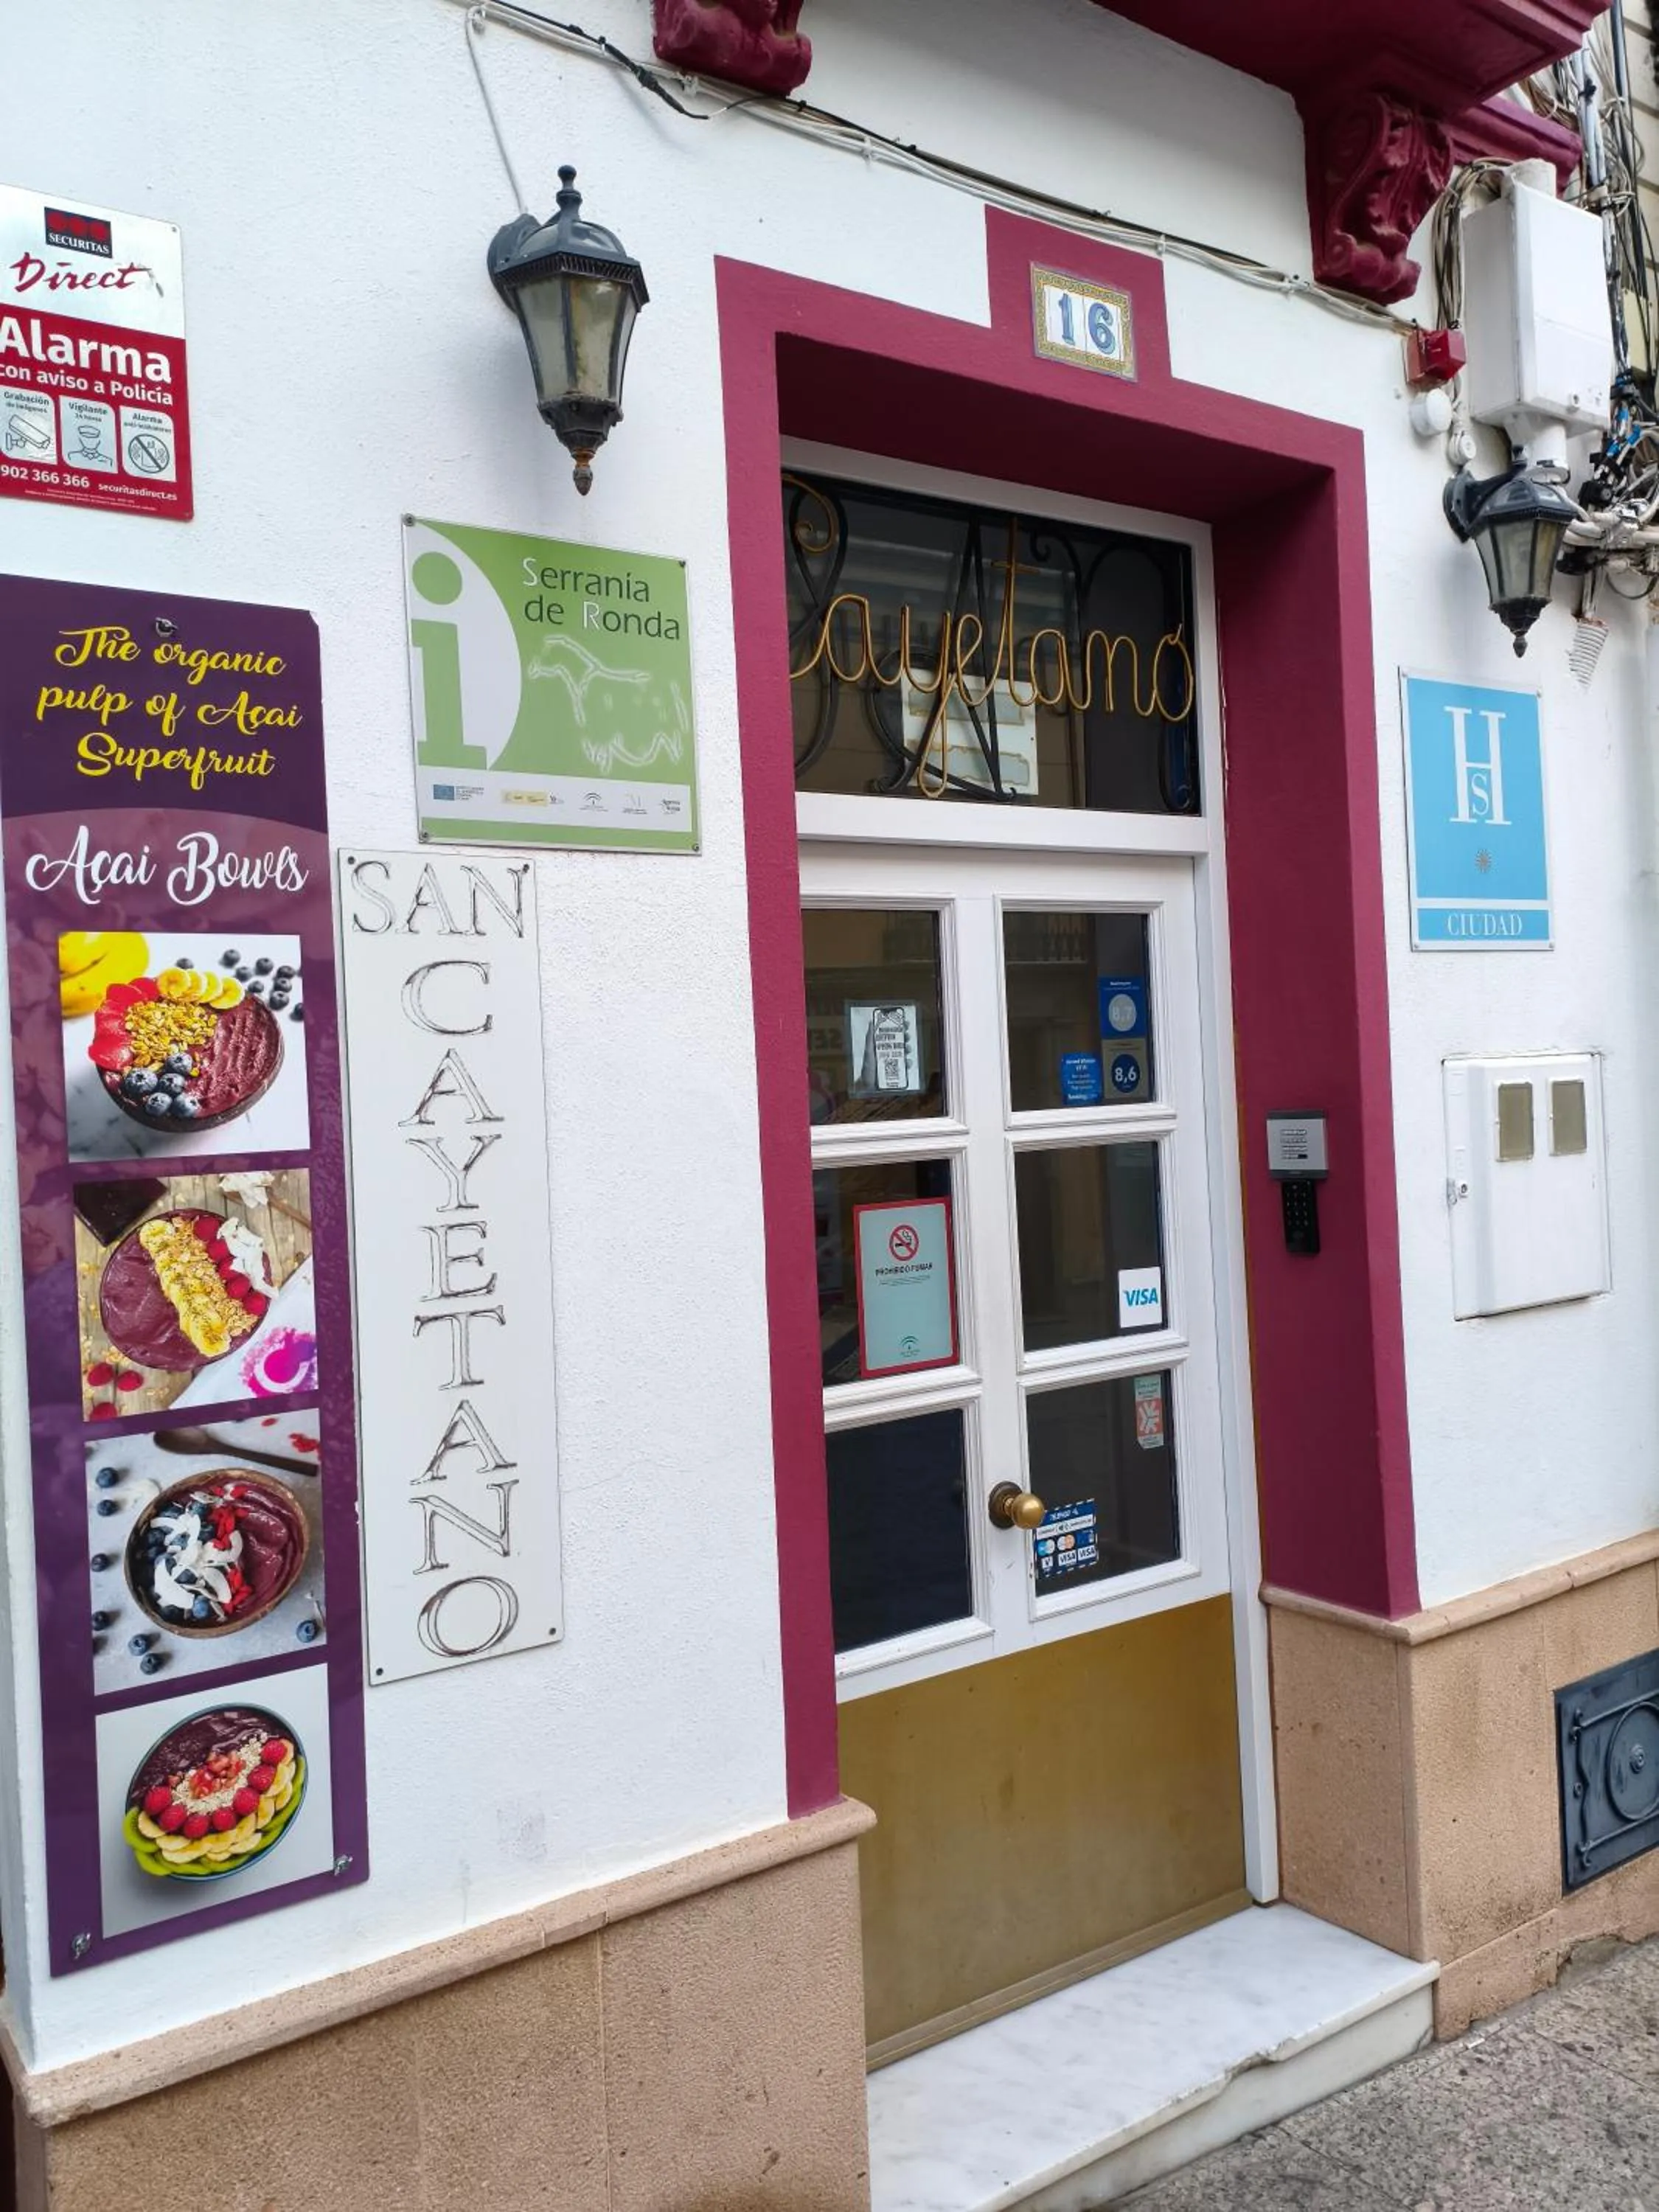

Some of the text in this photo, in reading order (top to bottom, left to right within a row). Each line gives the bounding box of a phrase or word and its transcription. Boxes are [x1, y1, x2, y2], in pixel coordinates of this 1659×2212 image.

[49, 232, 110, 254] SECURITAS
[10, 251, 152, 293] Direct
[1059, 293, 1116, 355] 16
[0, 316, 172, 384] Alarma
[4, 391, 49, 406] Grabación
[36, 369, 88, 391] aviso
[94, 380, 105, 394] a
[111, 381, 173, 406] Policía
[69, 402, 108, 415] Vigilante
[132, 412, 163, 424] Alarma
[0, 464, 90, 488] 902 366 366
[523, 556, 650, 603] Serranía
[524, 594, 681, 640] de Ronda
[54, 625, 287, 685] The organic
[787, 509, 1194, 799] ayetano
[35, 684, 304, 737] pulp of Açai
[76, 731, 276, 791] Superfruit
[25, 824, 310, 906] Açai Bowls
[350, 860, 524, 939] SAN
[1447, 913, 1523, 936] CIUDAD
[1115, 1067, 1137, 1084] 8,6
[397, 959, 520, 1658] CAYETANO
[1123, 1288, 1158, 1307] VISA
